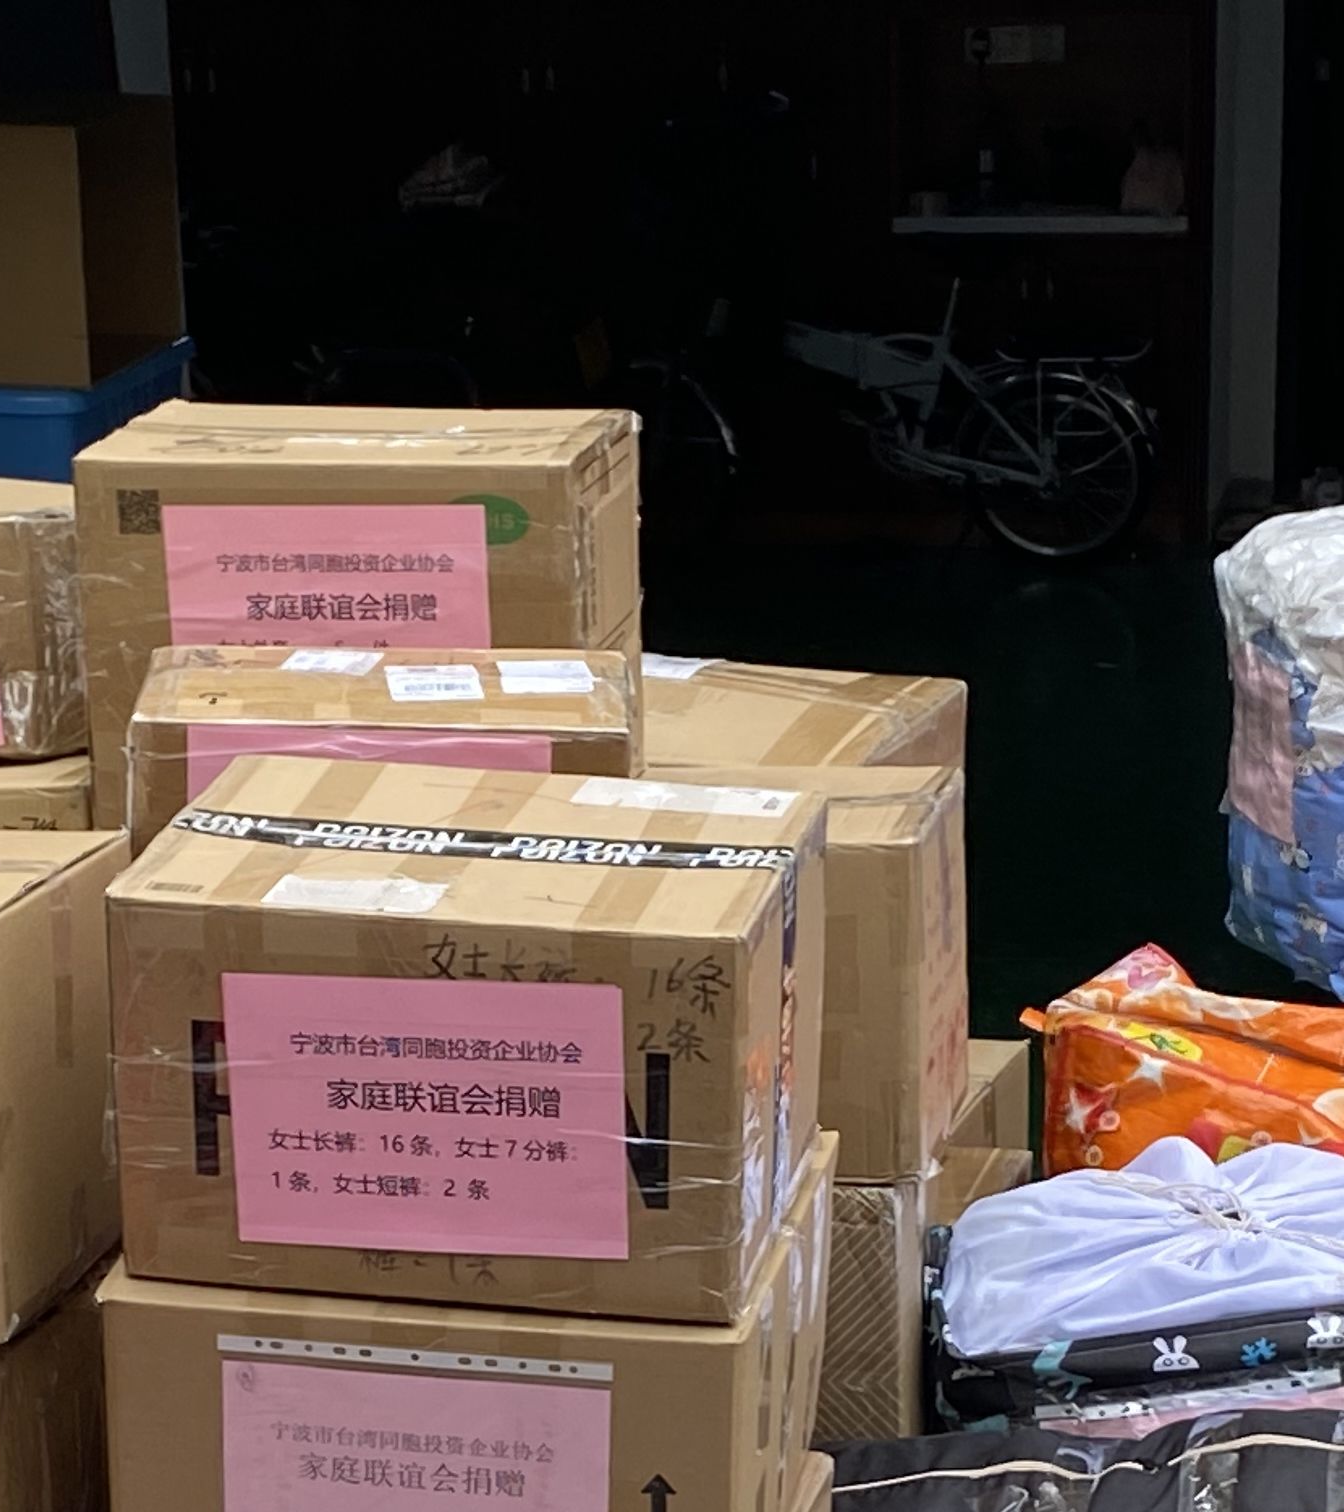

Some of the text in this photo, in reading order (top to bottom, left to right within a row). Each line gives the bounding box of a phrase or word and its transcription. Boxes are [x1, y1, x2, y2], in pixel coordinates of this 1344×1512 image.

[217, 554, 453, 575] 宁波市台湾同胞投资企业协会
[246, 592, 437, 622] 家庭联谊会捐赠
[289, 1032, 583, 1064] 宁波市台湾同胞投资企业协会
[326, 1080, 560, 1120] 家庭联谊会捐赠
[271, 1420, 554, 1464] 宁波市台湾同胞投资企业协会
[298, 1452, 526, 1498] 家庭联谊会捐赠
